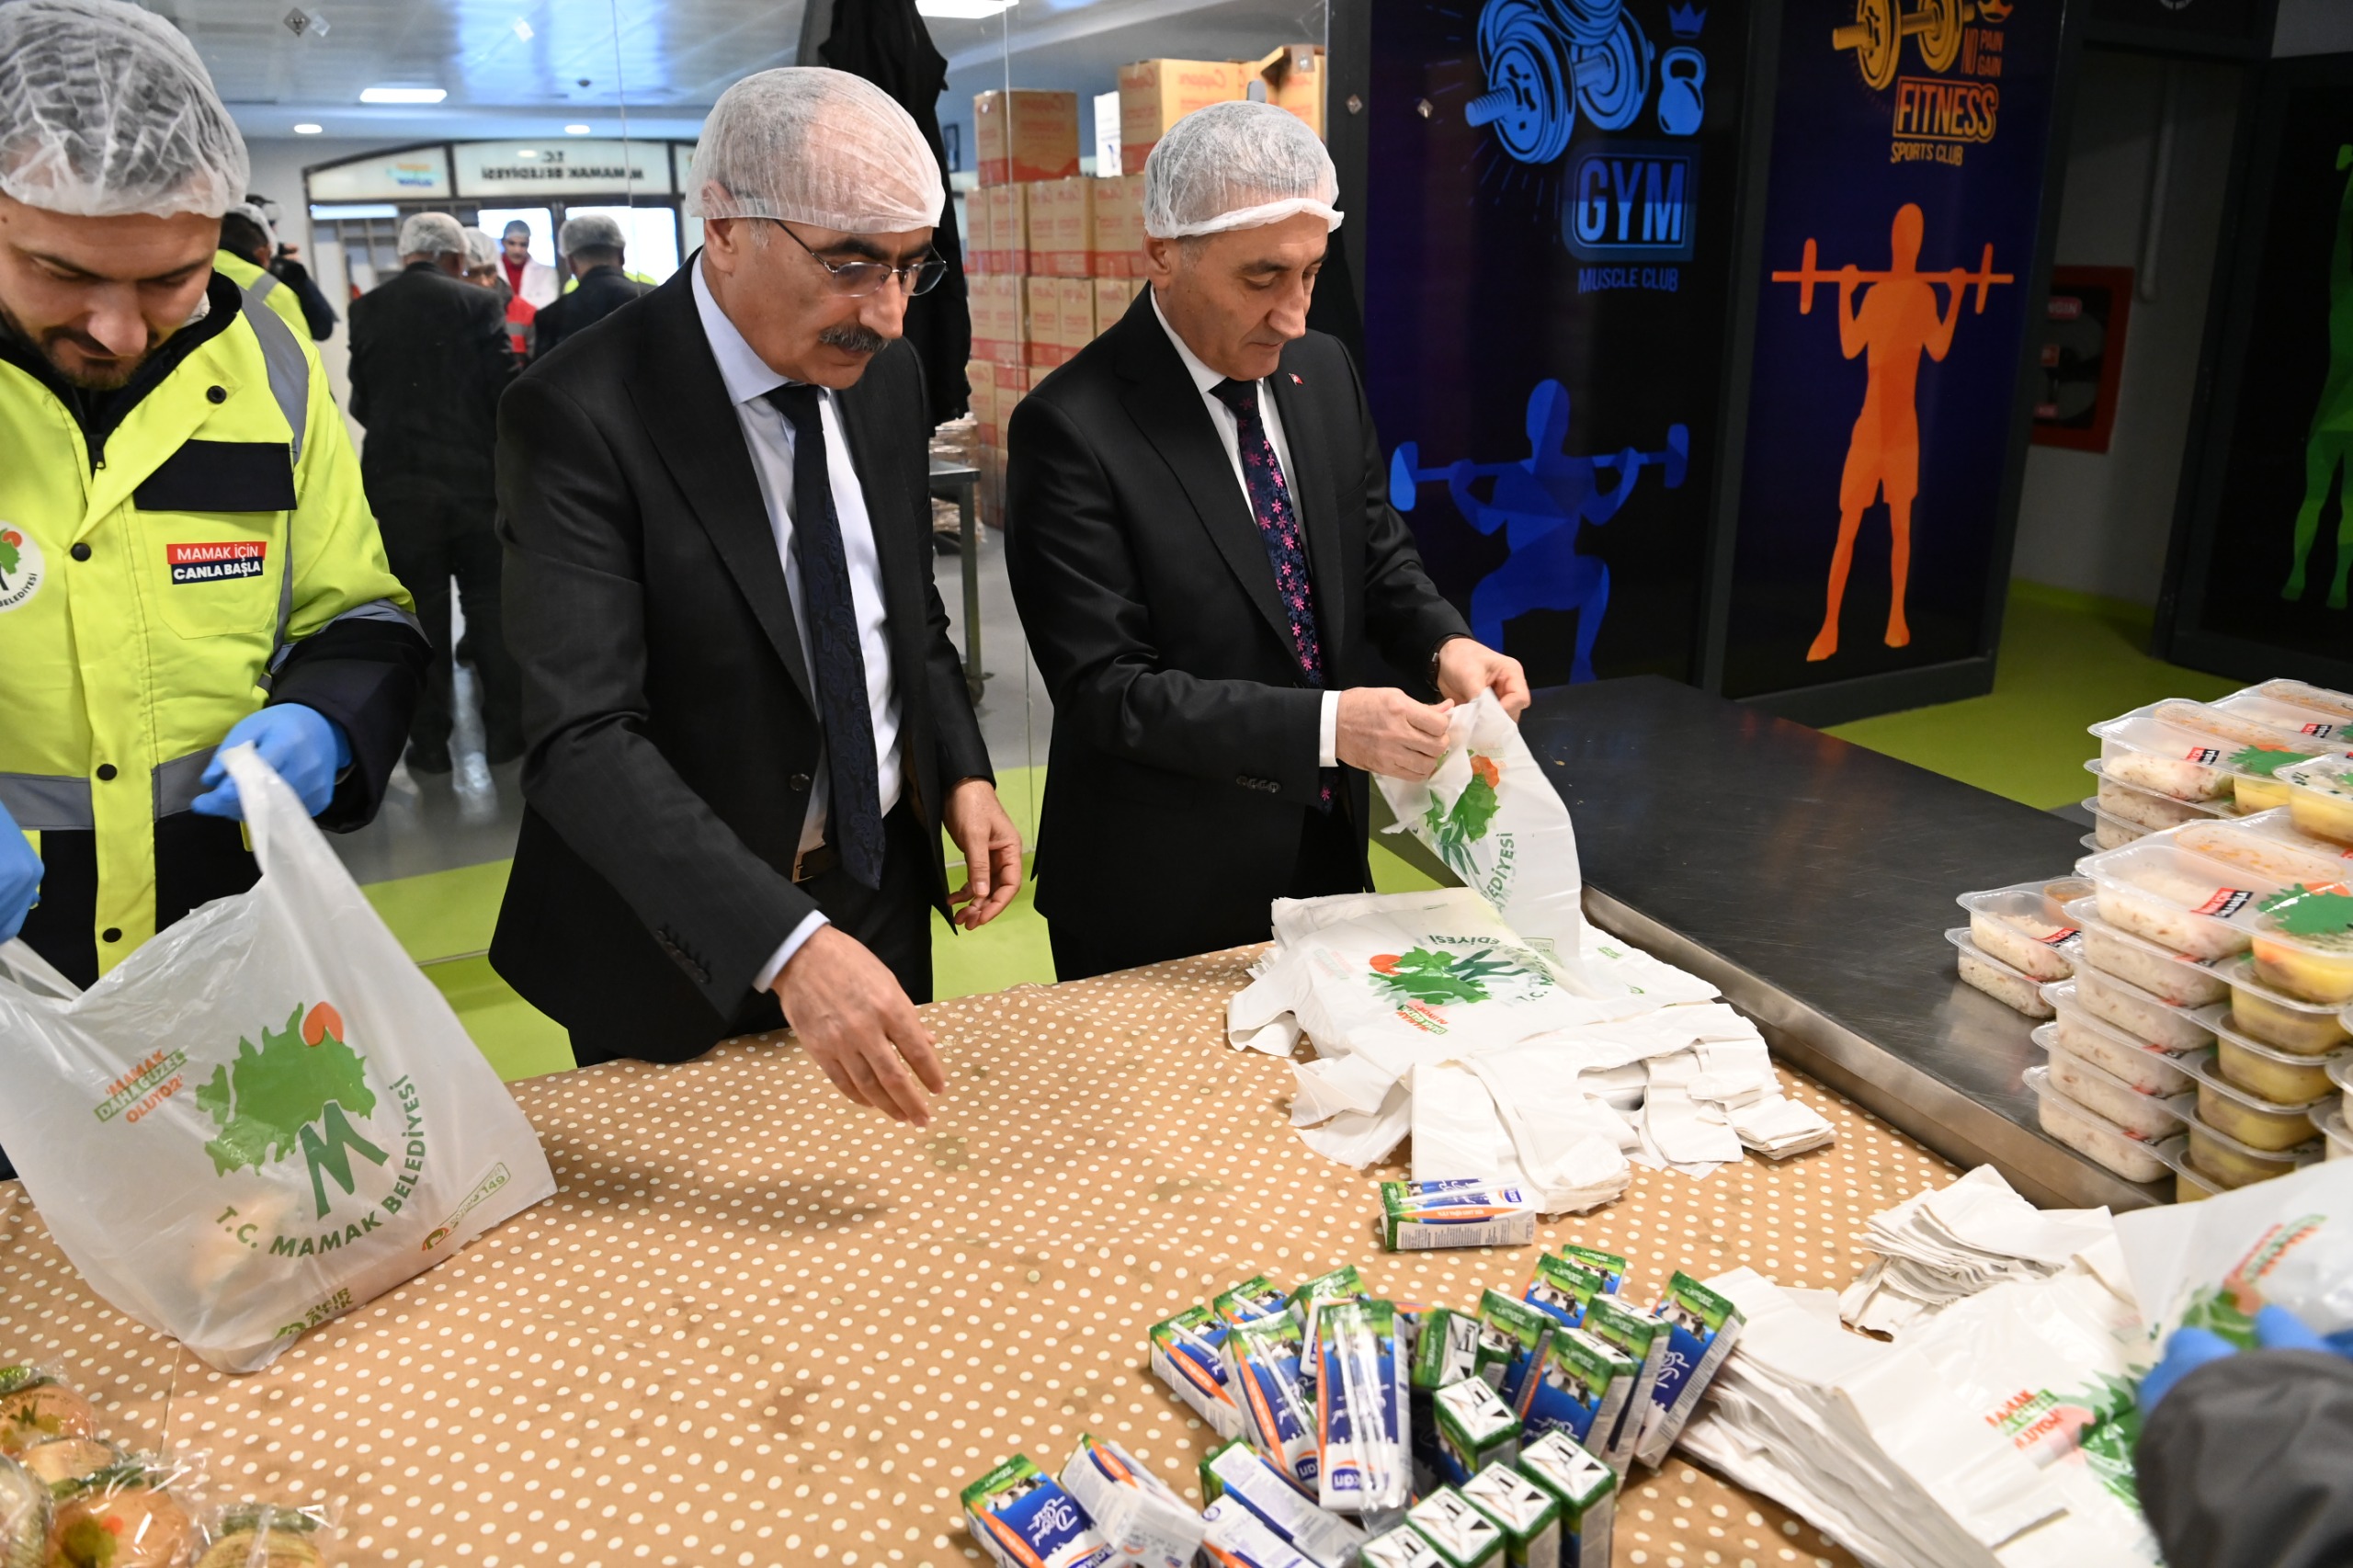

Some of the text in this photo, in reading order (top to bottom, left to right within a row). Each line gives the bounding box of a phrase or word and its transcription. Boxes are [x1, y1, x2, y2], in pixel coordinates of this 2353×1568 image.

[1980, 29, 2004, 52] PAIN
[1977, 55, 2002, 77] GAIN
[1897, 83, 1995, 137] FITNESS
[1891, 142, 1964, 166] SPORTS CLUB
[1577, 159, 1685, 242] GYM
[1578, 267, 1679, 294] MUSCLE CLUB
[176, 544, 258, 562] MAMAK İÇİN
[173, 560, 261, 581] CANLA BAŞLA
[216, 1074, 426, 1258] T.C. MAMAK BELEDİYESİ
